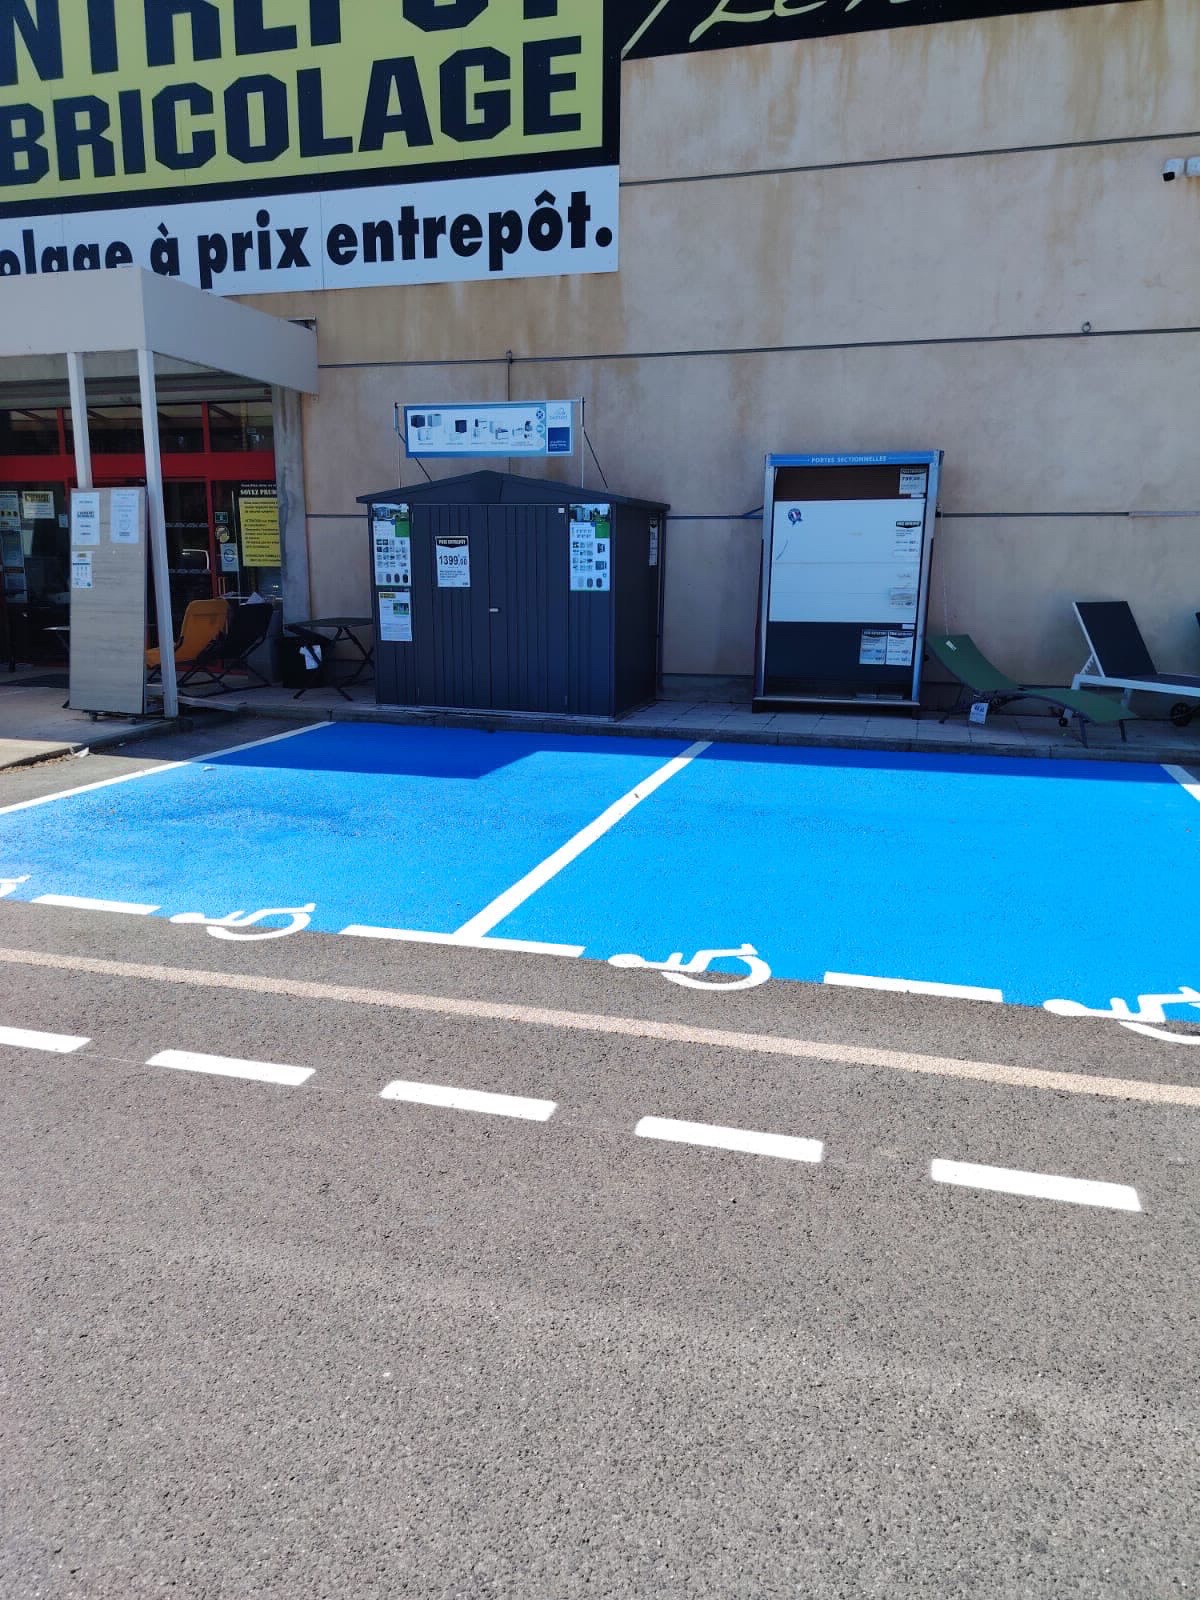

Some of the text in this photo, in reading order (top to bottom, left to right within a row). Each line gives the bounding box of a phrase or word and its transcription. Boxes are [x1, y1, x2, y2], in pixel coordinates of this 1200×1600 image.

[0, 35, 582, 187] BRICOLAGE
[150, 222, 180, 277] à
[198, 209, 311, 290] prix
[327, 190, 613, 272] entrepôt.
